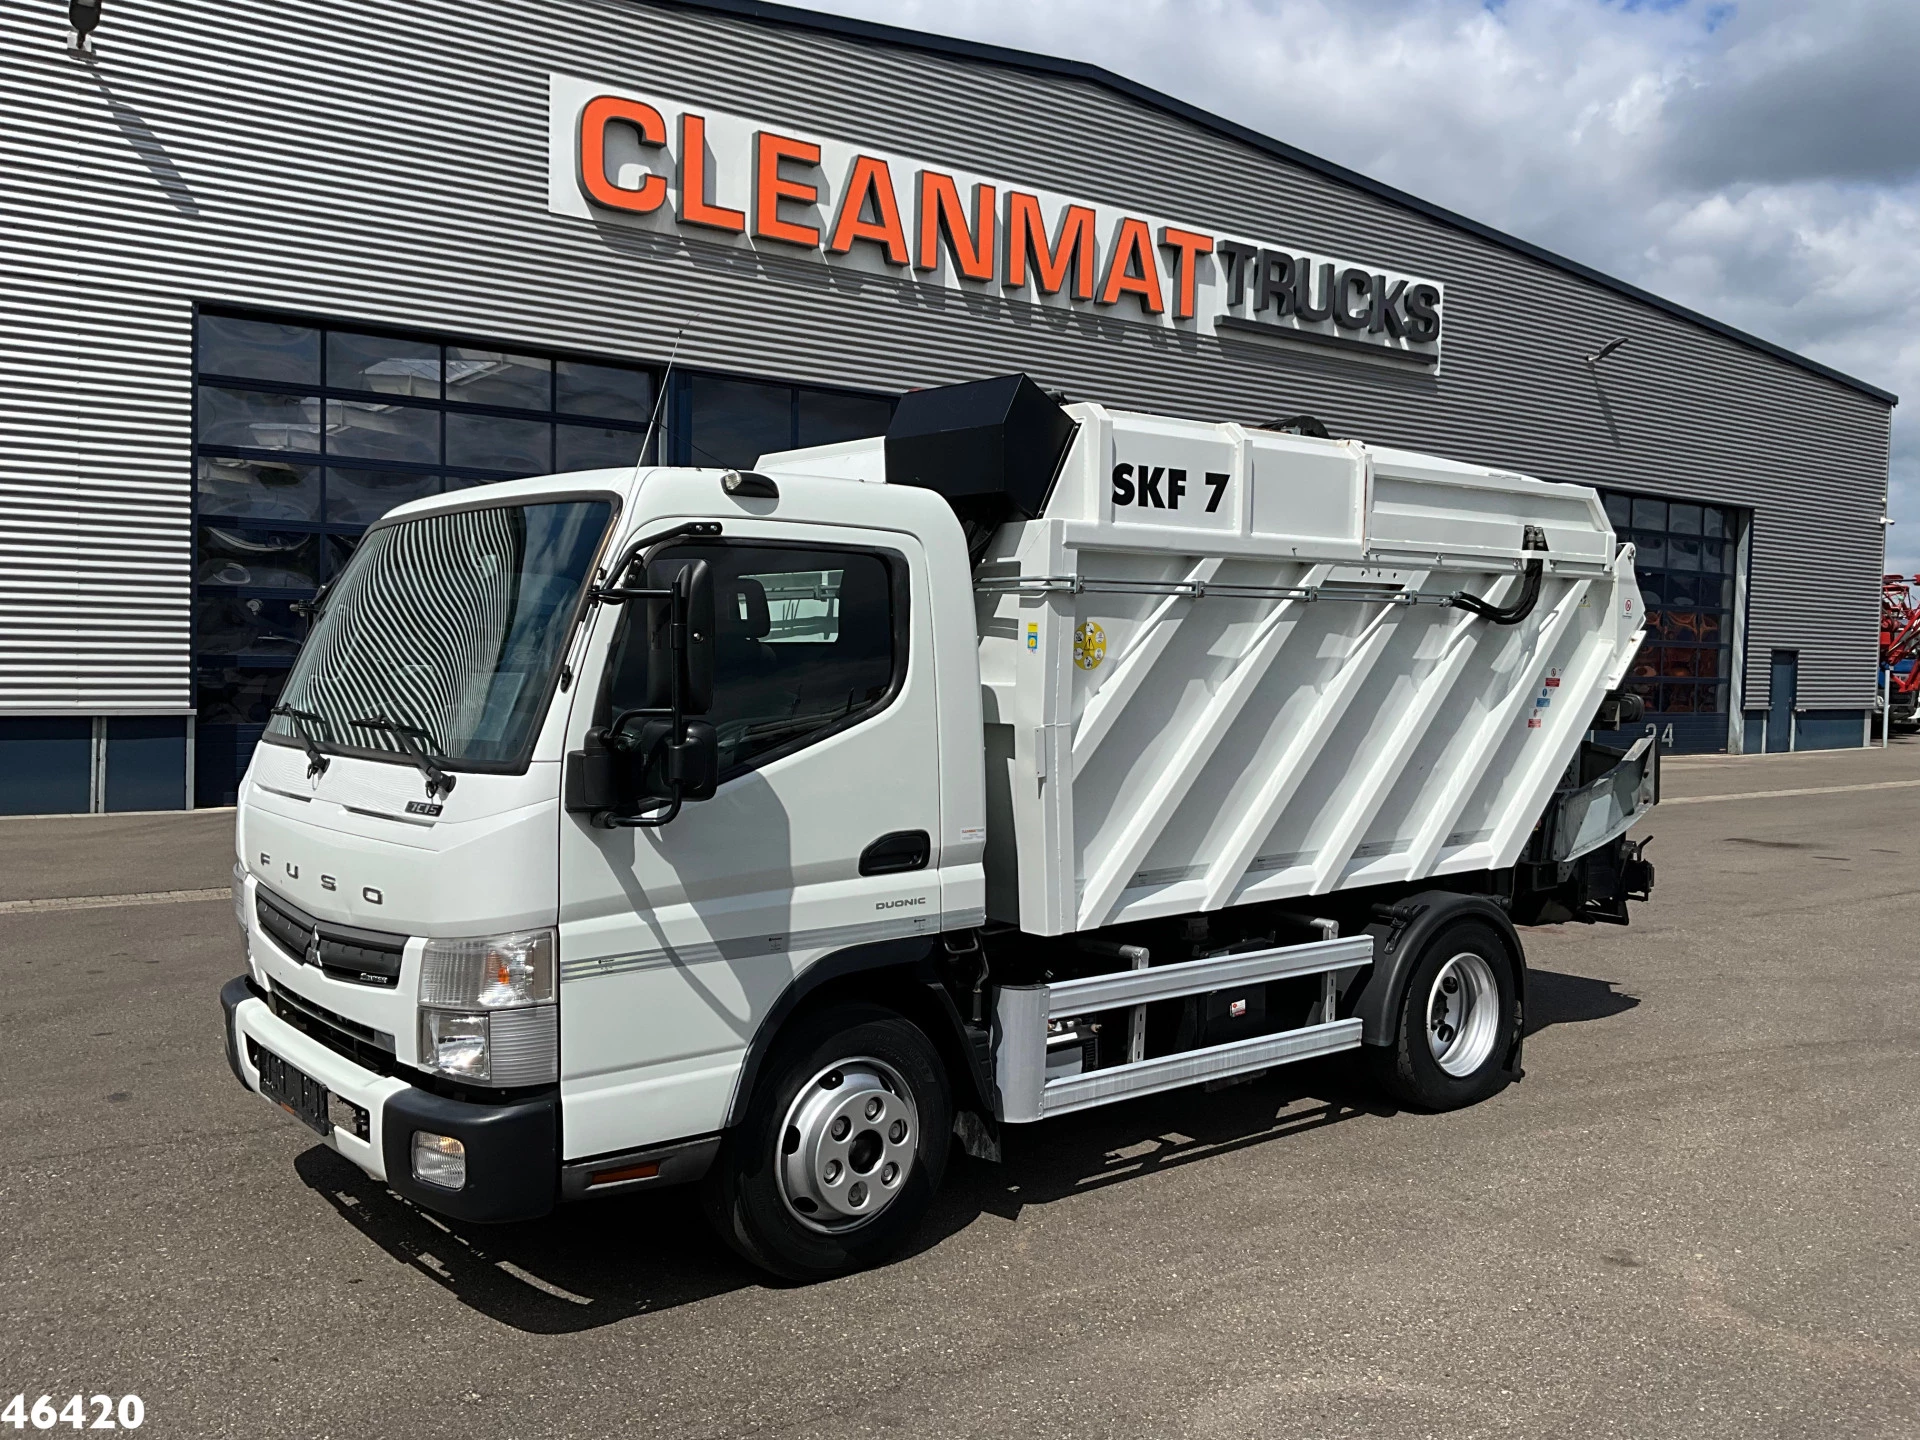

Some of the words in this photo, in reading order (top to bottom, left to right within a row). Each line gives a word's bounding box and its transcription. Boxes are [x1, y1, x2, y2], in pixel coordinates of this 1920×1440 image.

[575, 94, 1214, 320] CLEANMAT
[1216, 239, 1441, 343] TRUCKS
[1111, 462, 1187, 510] SKF
[1204, 471, 1231, 513] 7
[1644, 722, 1675, 748] 24
[411, 802, 439, 815] 7C15
[260, 852, 384, 905] FUSO
[875, 897, 927, 910] DUONIC
